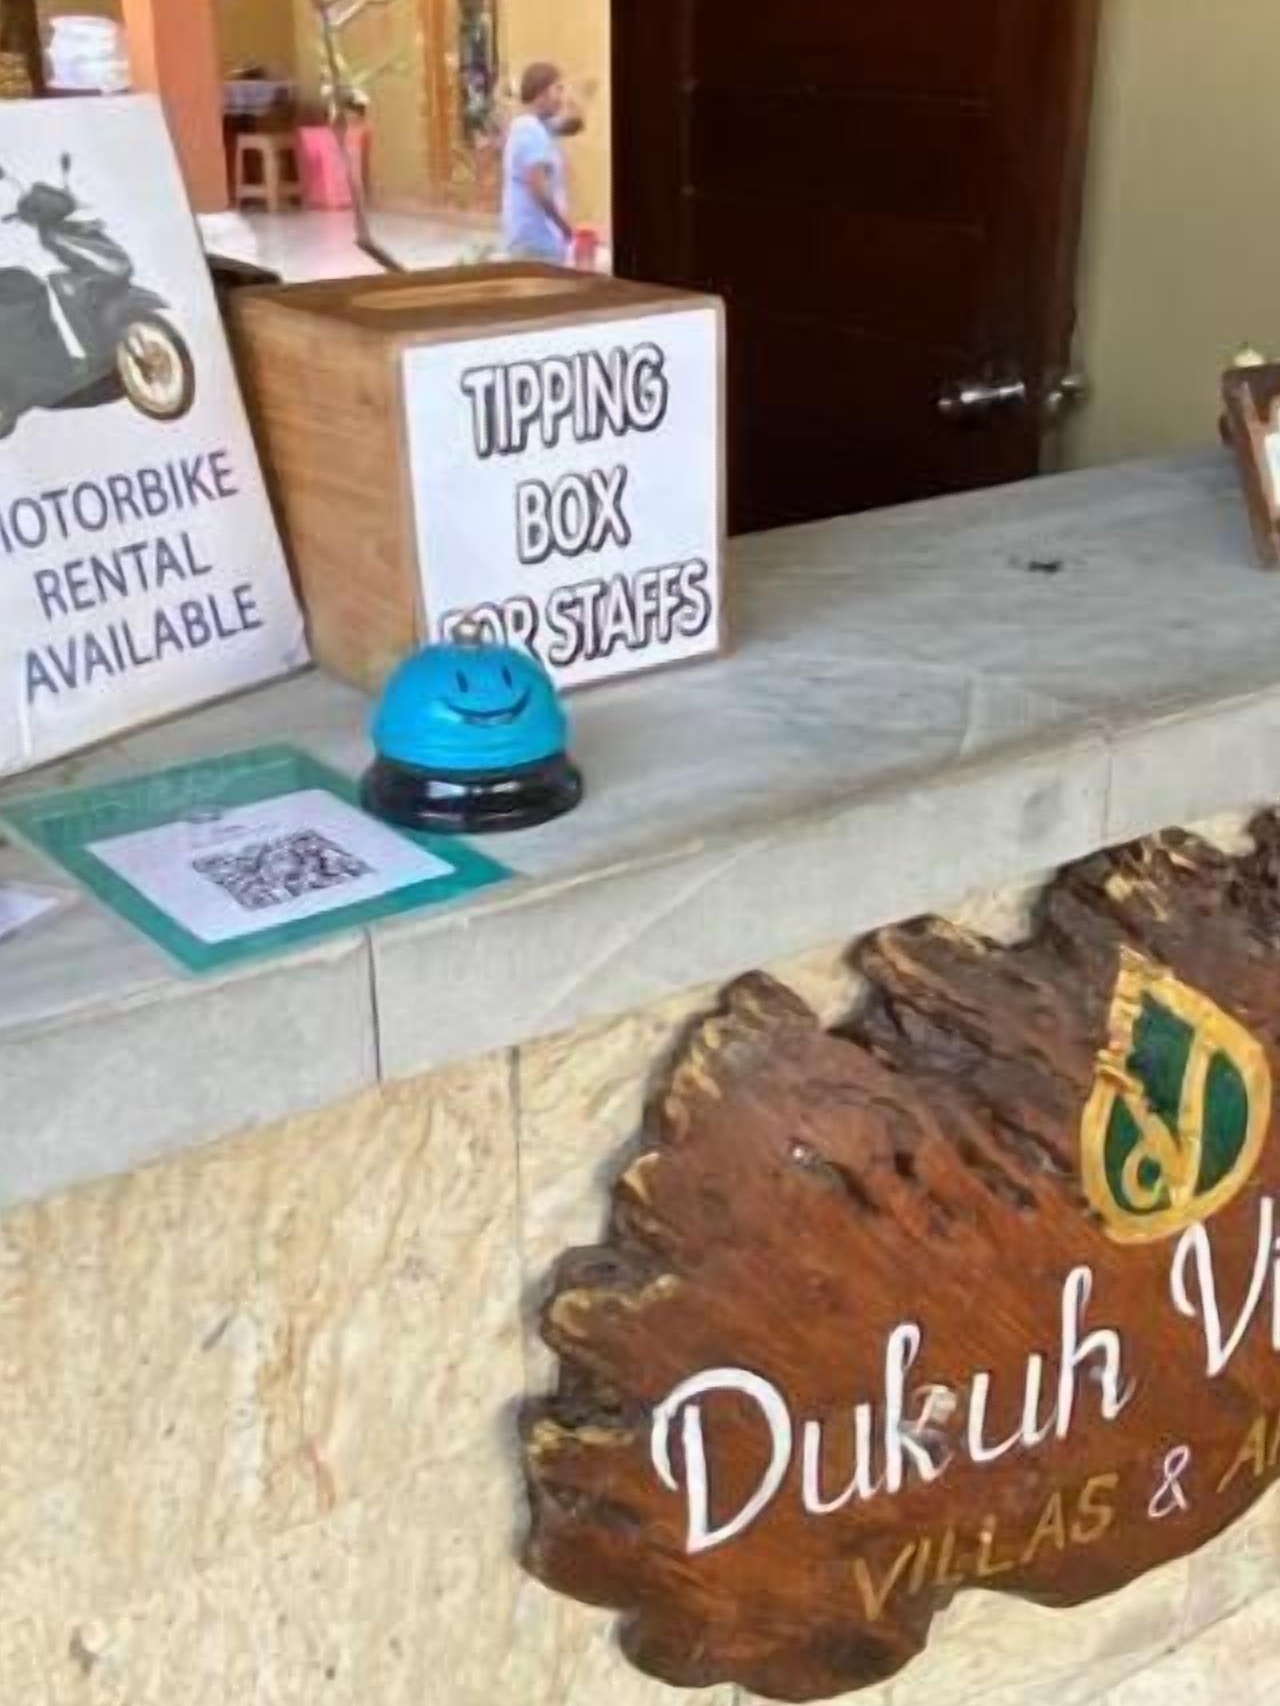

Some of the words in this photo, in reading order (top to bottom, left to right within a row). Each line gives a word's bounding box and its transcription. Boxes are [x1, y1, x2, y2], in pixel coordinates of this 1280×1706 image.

[460, 341, 669, 459] TIPPING
[515, 464, 632, 565] BOX
[33, 531, 213, 622] RENTAL
[545, 557, 713, 668] STAFFS
[26, 583, 265, 705] AVAILABLE
[650, 1266, 1133, 1555] Dukuh
[853, 1470, 1119, 1623] VILLAS
[1146, 1443, 1193, 1519] &
